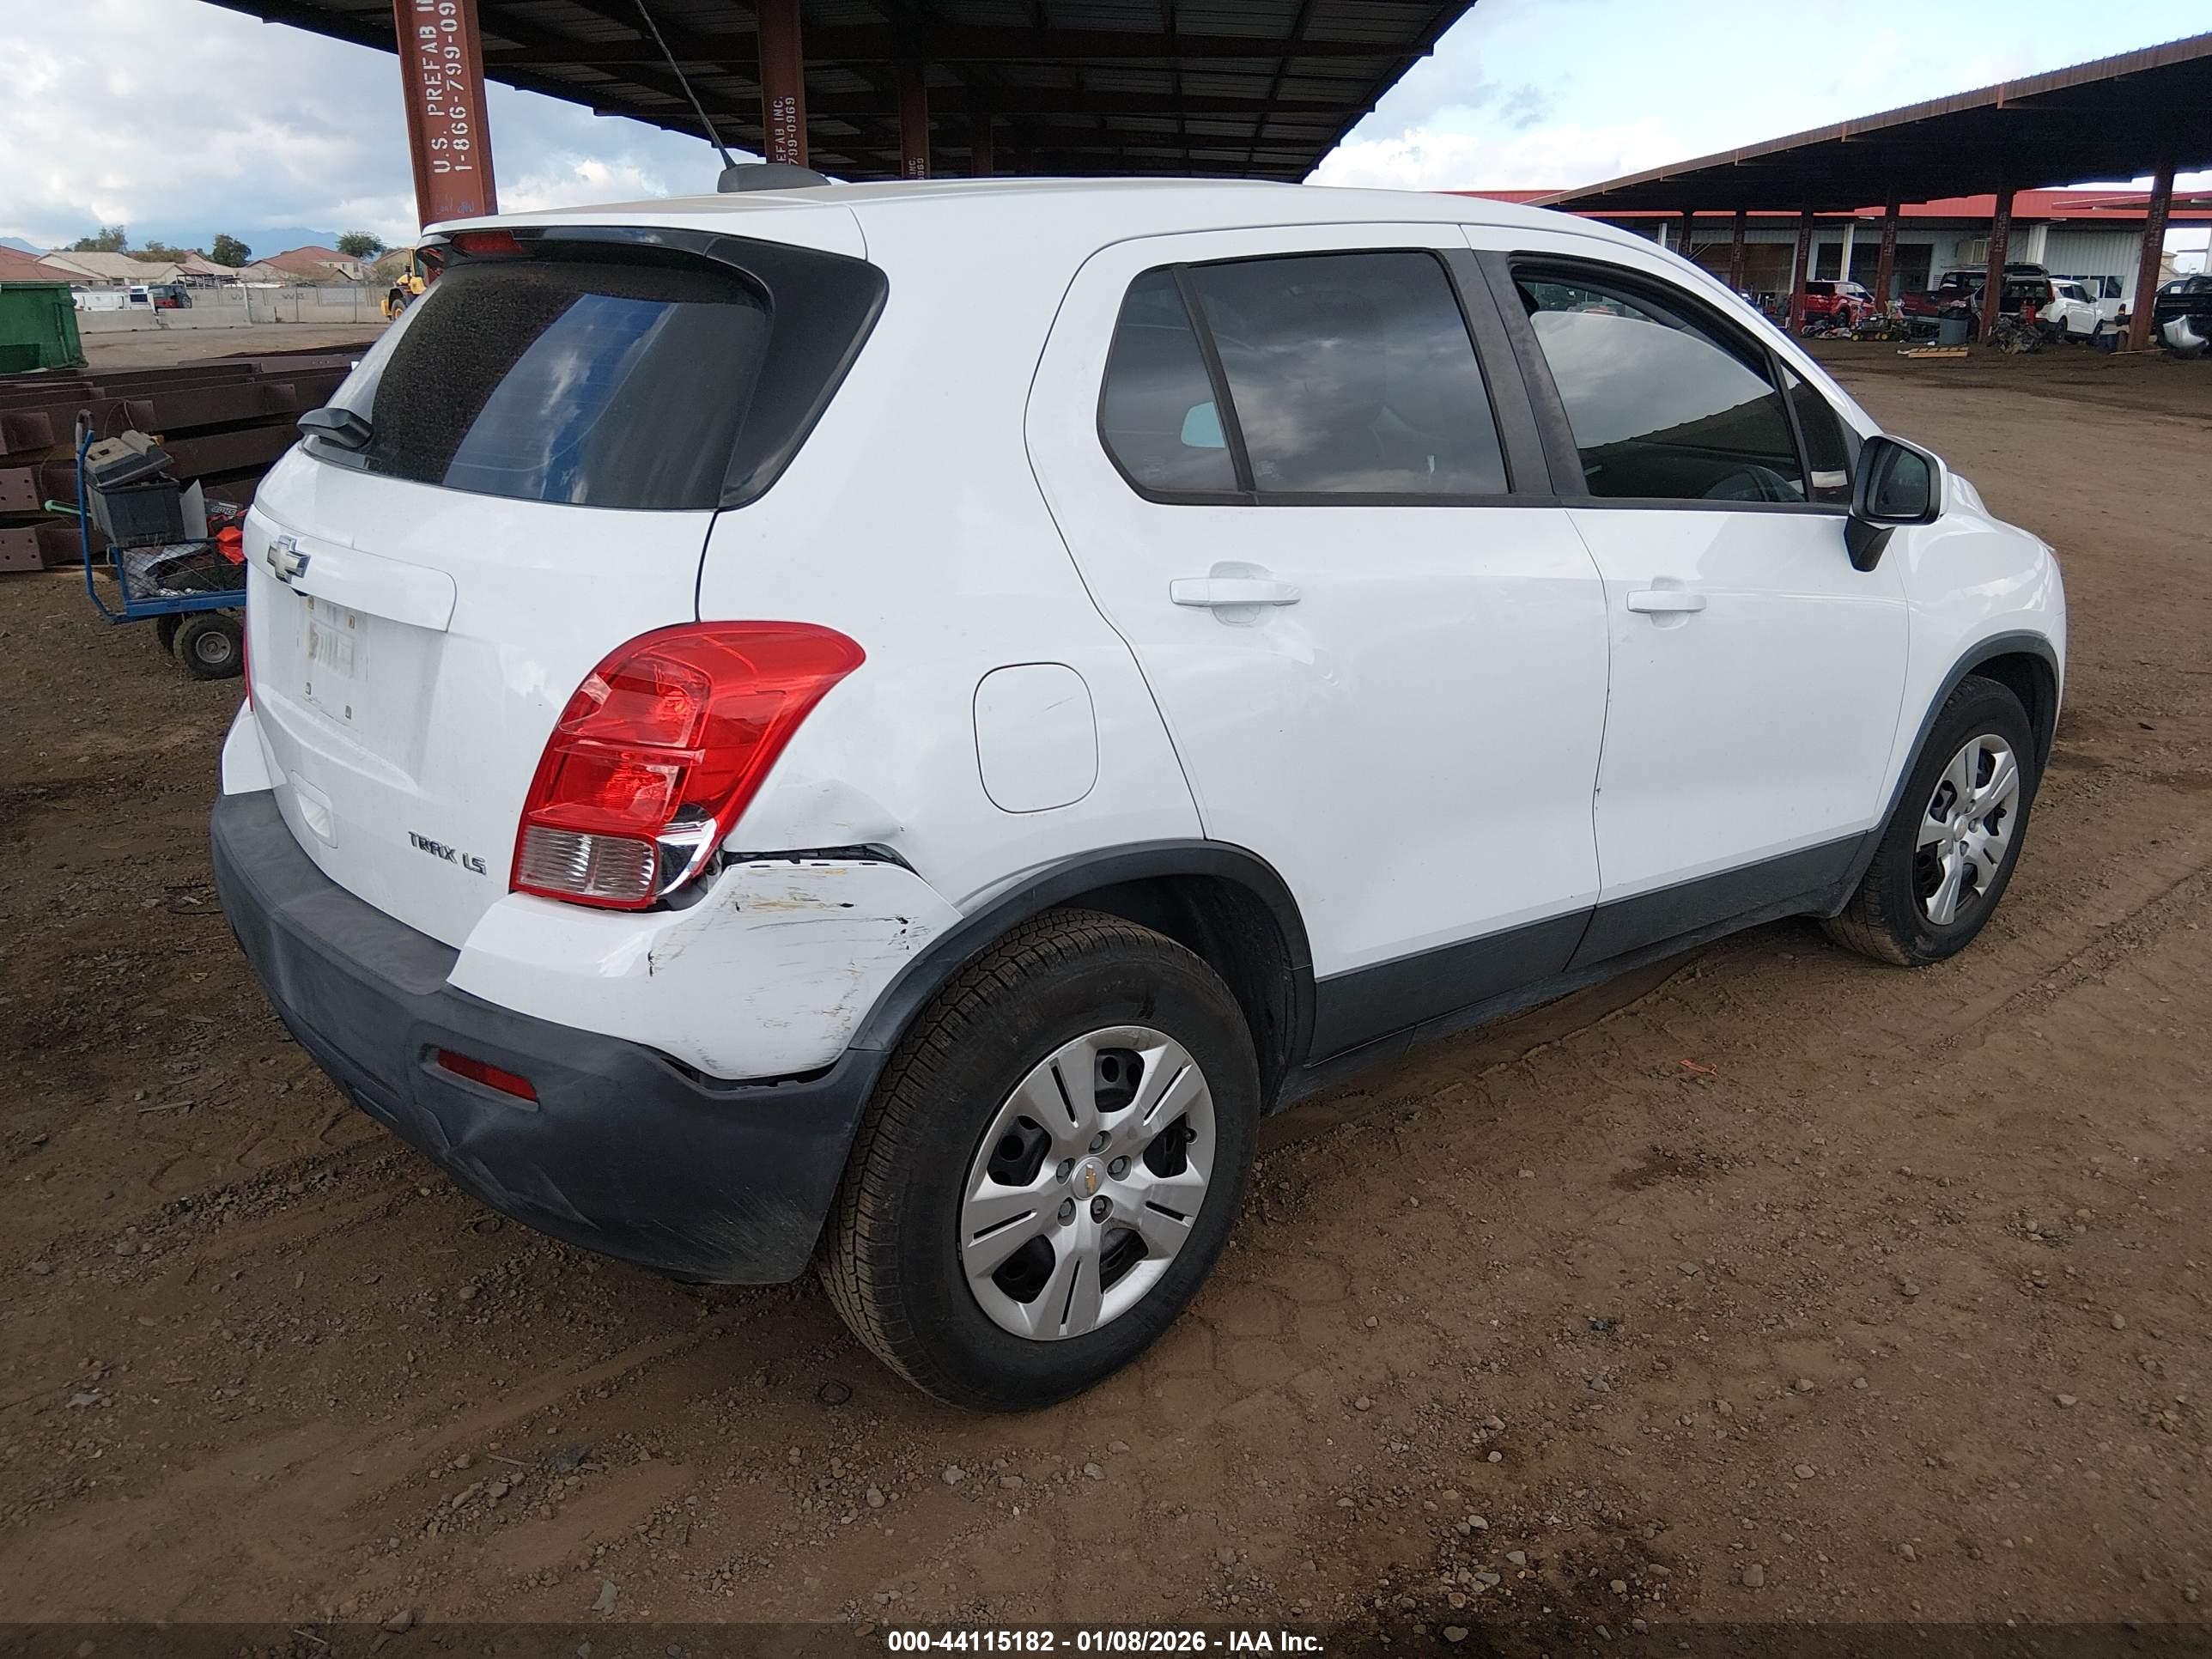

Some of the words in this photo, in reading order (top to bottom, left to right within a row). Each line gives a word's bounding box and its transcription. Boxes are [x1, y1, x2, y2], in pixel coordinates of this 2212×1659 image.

[418, 25, 446, 116] PREFAB
[438, 1, 473, 172] 1-866-799-09
[772, 95, 784, 121] INC.
[431, 131, 452, 173] U.S.
[775, 128, 787, 165] EFAB
[408, 830, 458, 865] TRAX
[462, 852, 487, 876] LS
